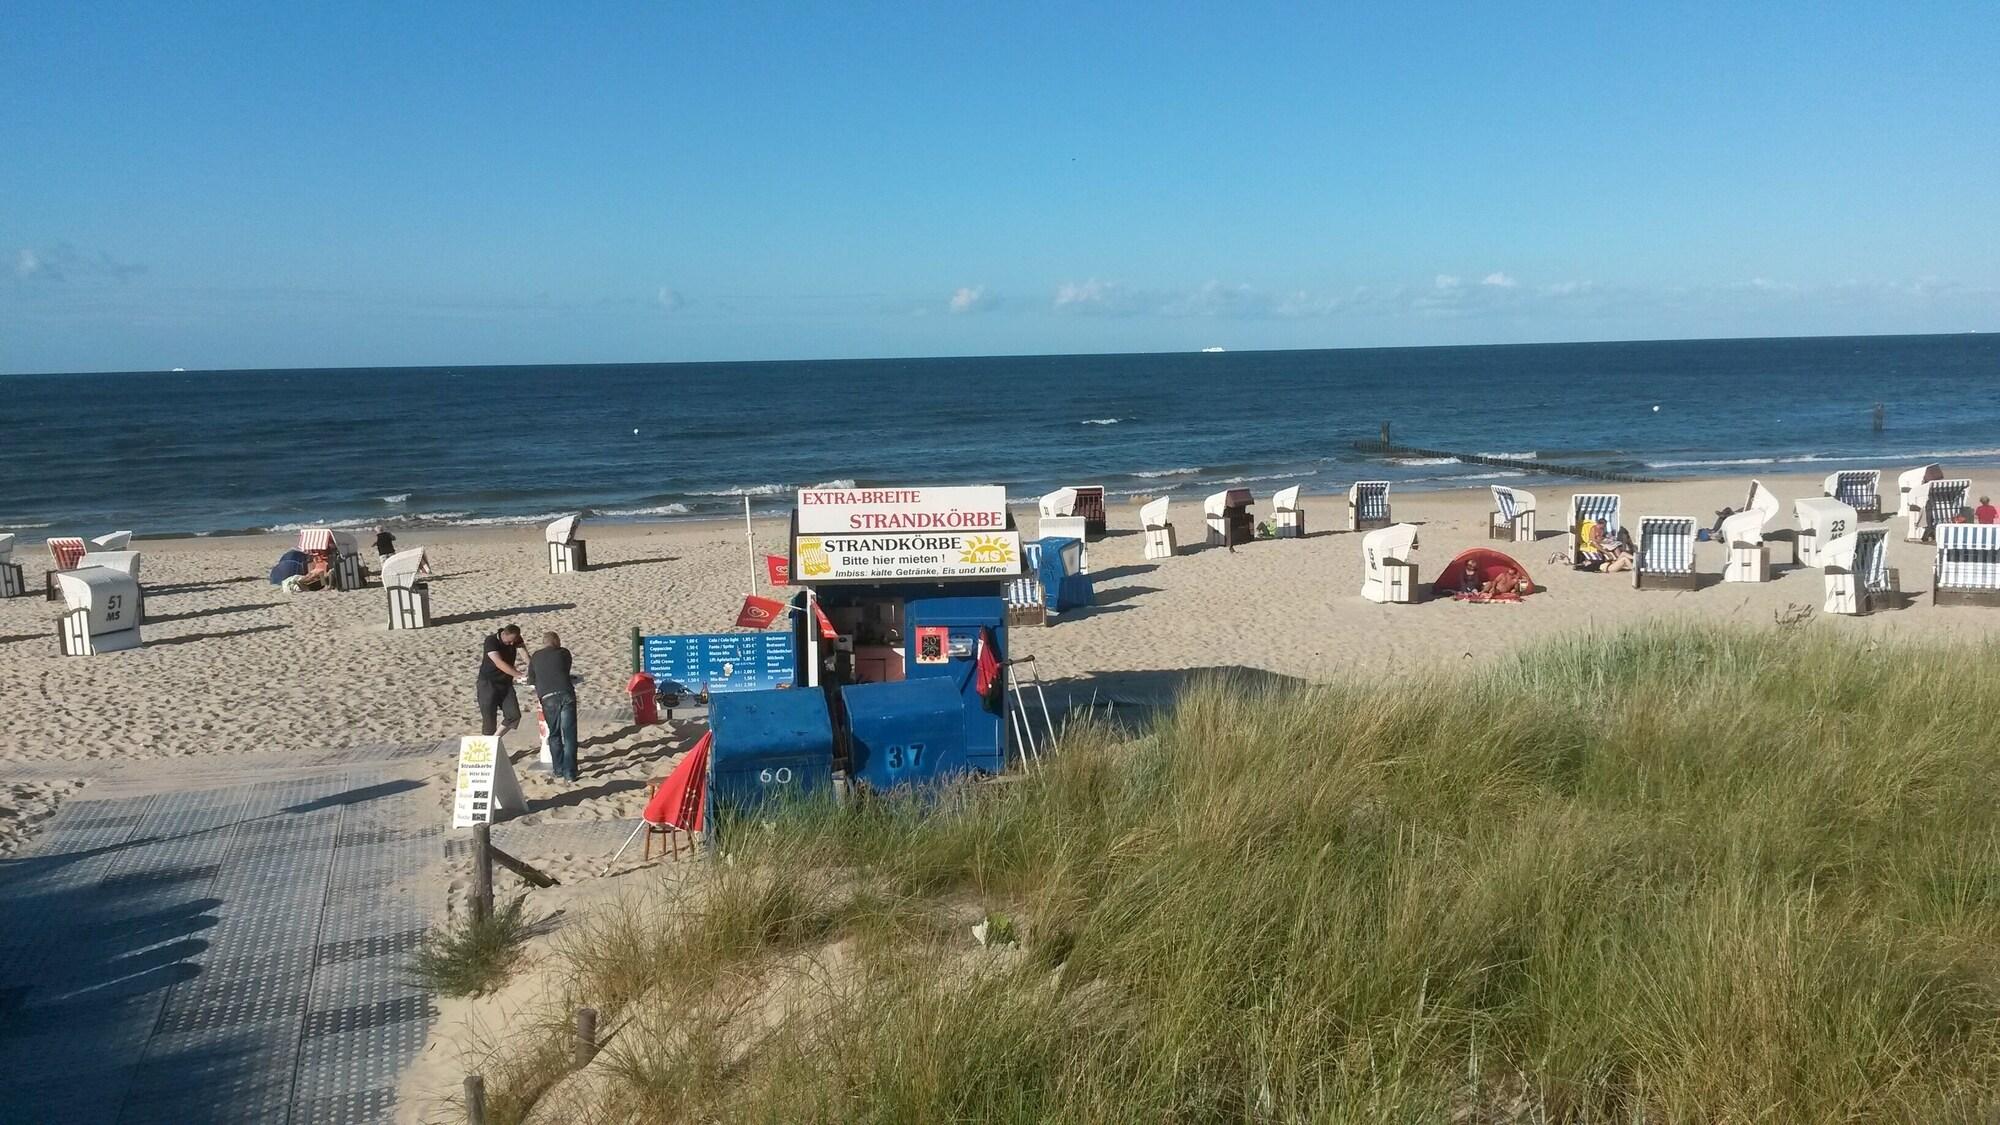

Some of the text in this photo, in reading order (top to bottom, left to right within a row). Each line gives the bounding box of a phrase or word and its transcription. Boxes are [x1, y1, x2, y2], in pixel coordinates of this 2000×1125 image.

[803, 490, 921, 505] EXTRA-BREITE
[849, 508, 1002, 529] STRANDKÖRBE
[1831, 519, 1846, 532] 23
[824, 534, 962, 553] STRANDKÖRBE
[842, 556, 869, 566] Bitte
[873, 556, 895, 565] hier
[899, 555, 938, 564] mieten
[974, 550, 1001, 562] MS
[871, 569, 892, 577] kalte
[942, 567, 956, 575] Eis
[959, 566, 976, 574] und
[979, 565, 1007, 574] Kaffee
[107, 594, 122, 610] 51
[105, 610, 121, 622] MS
[888, 743, 925, 769] 37
[759, 767, 792, 784] 60
